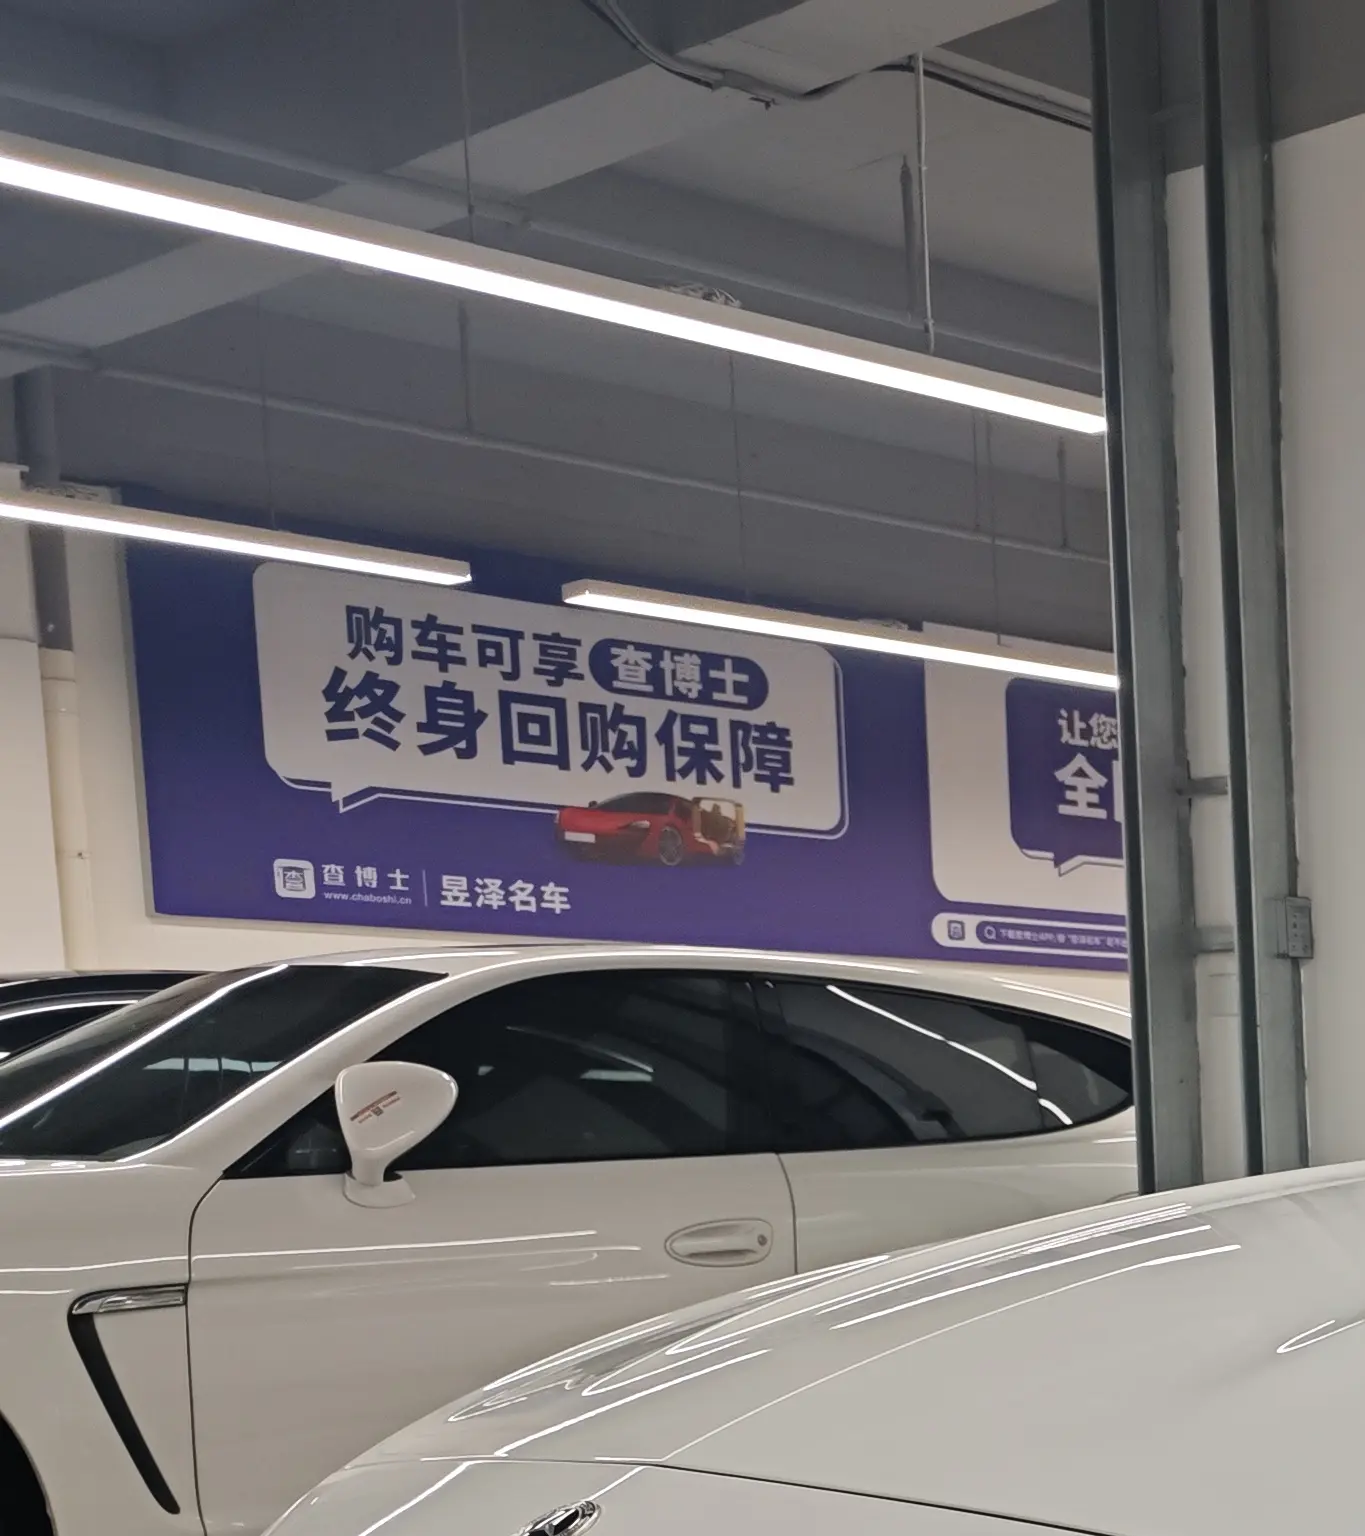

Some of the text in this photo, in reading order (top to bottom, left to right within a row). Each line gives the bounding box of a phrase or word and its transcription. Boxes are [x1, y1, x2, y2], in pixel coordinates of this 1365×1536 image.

[345, 604, 752, 706] 购车可享 查博士
[321, 665, 796, 796] 终身回购保障
[1057, 708, 1119, 750] 让您
[1054, 752, 1122, 824] 全
[321, 863, 410, 892] 查博士
[440, 874, 571, 914] 昱泽名车
[323, 890, 412, 906] www.chaboshi.cn
